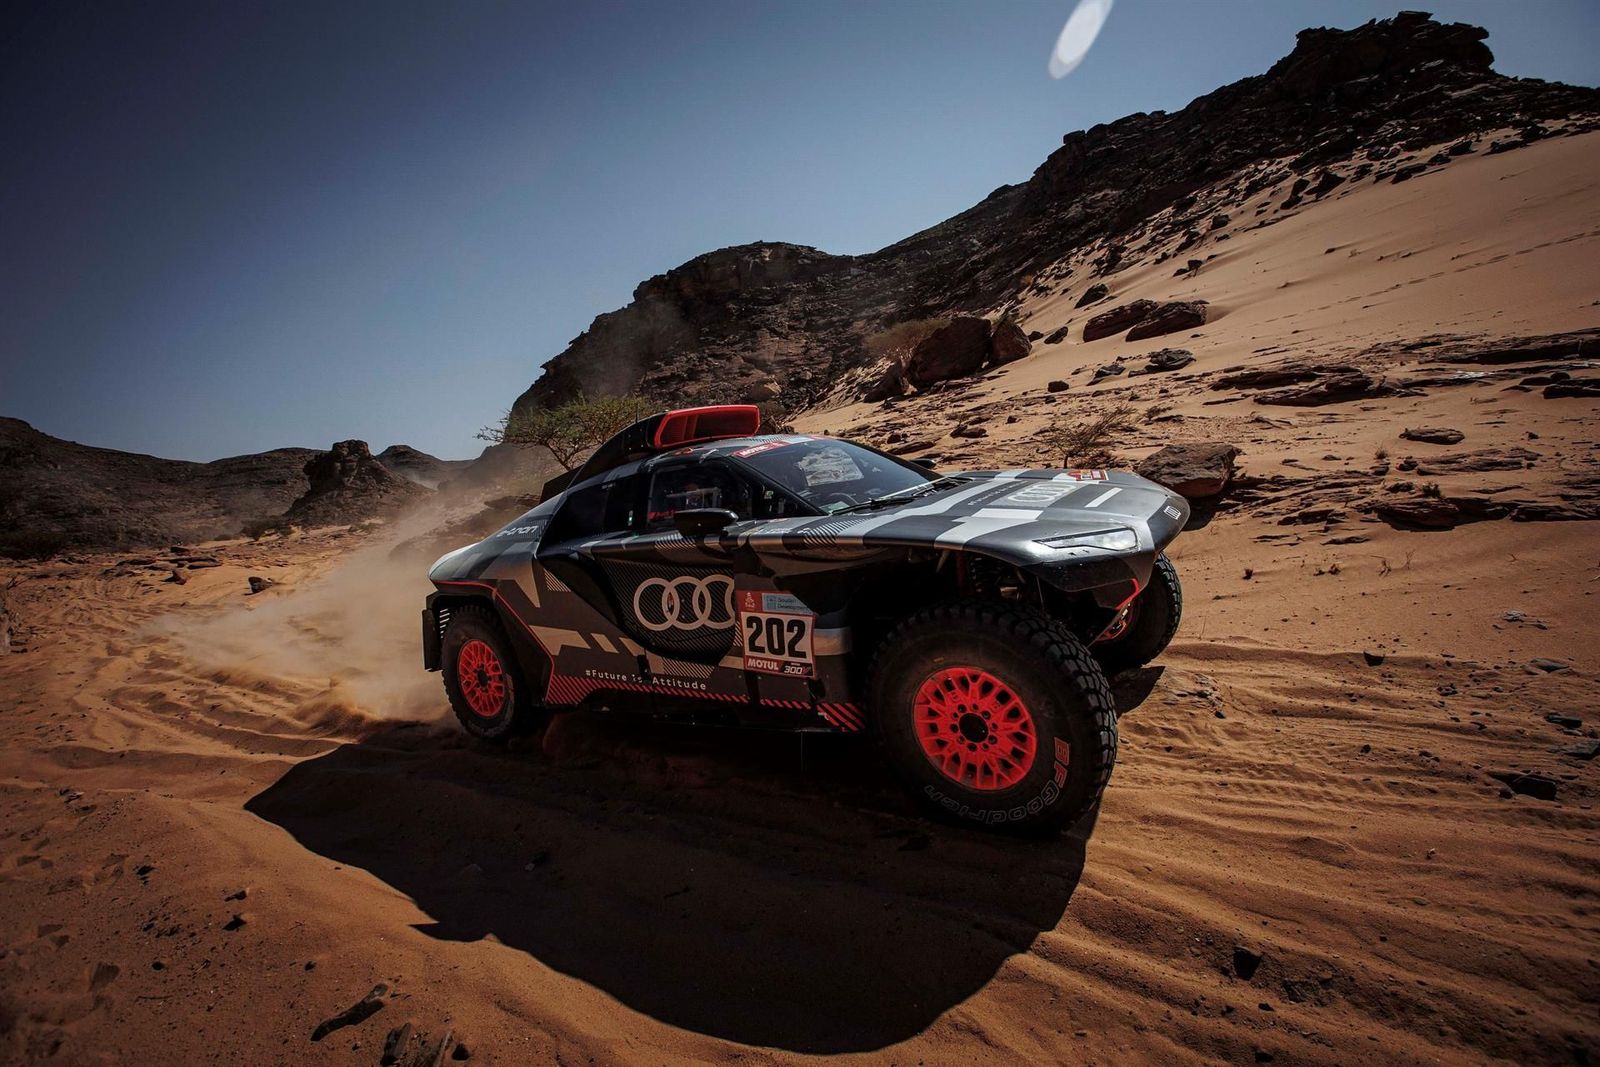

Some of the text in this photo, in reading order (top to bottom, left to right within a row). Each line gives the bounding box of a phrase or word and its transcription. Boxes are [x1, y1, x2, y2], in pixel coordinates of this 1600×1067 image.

[746, 615, 807, 659] 202
[585, 669, 628, 681] #Future
[652, 676, 707, 690] Attitude
[748, 658, 779, 670] MOTUL
[923, 736, 1072, 825] BFGoodrich
